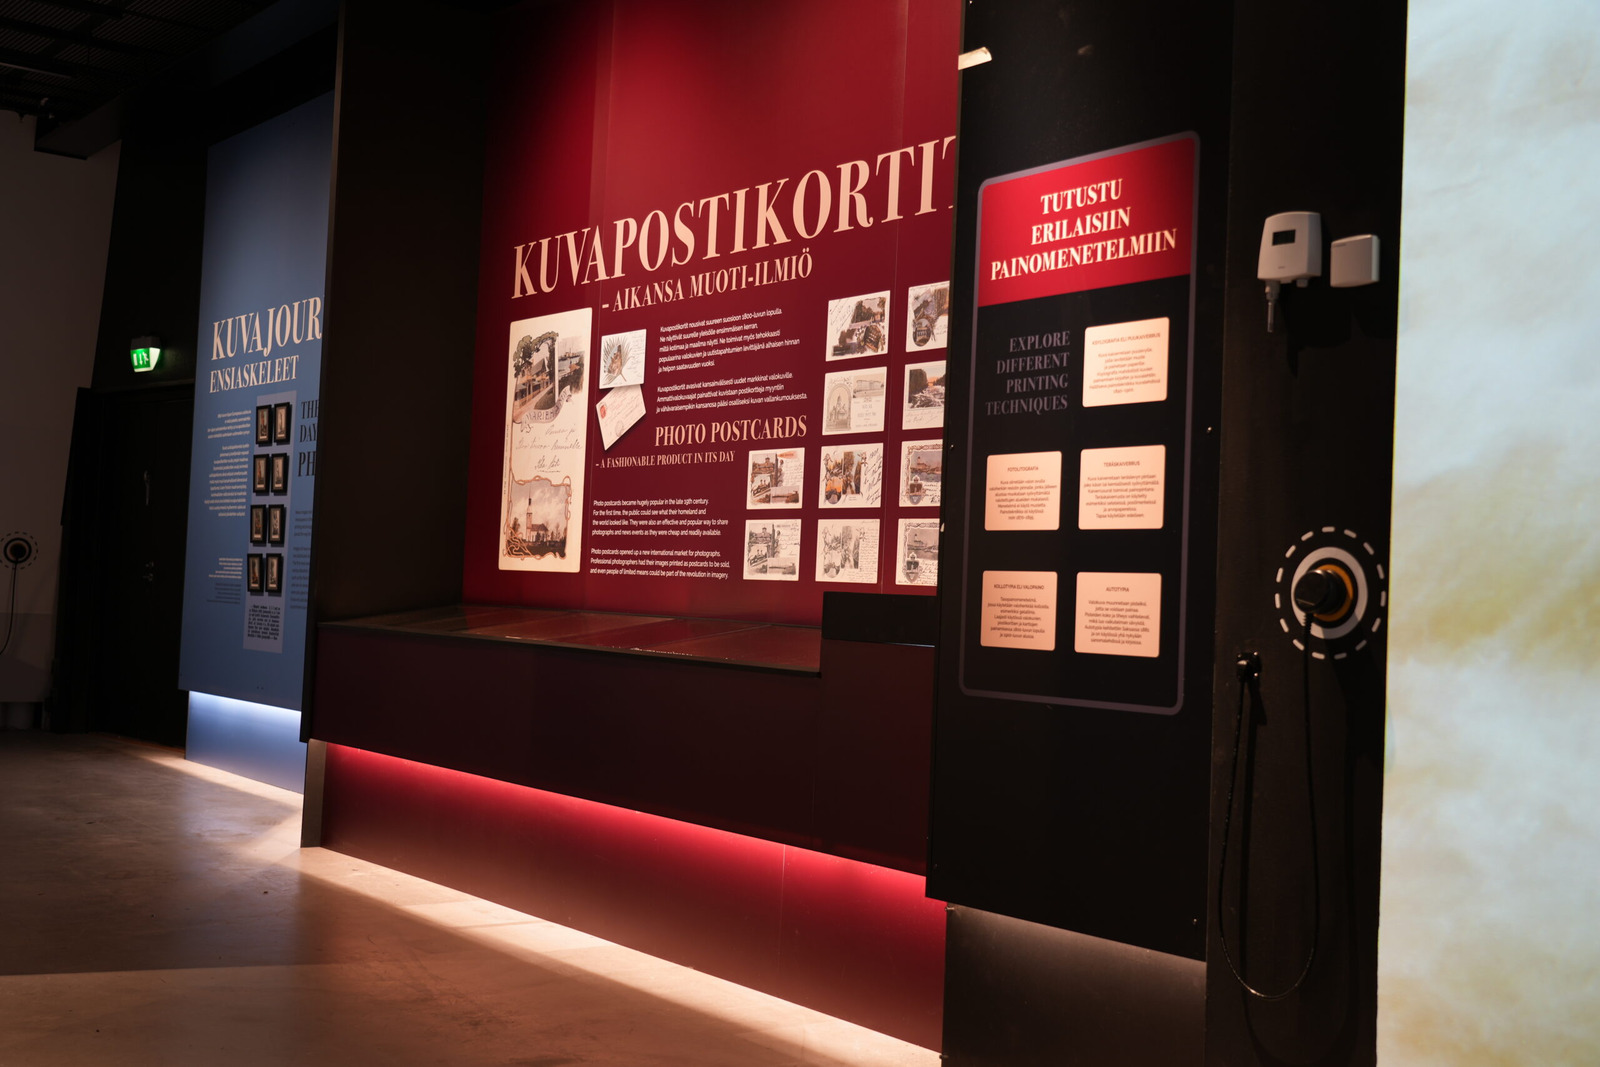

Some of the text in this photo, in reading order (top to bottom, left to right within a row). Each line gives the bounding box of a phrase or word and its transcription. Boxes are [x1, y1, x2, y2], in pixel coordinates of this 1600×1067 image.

[1040, 178, 1122, 215] TUTUSTU
[1031, 206, 1132, 246] ERILAISIIN
[990, 228, 1178, 281] PAINOMENETELMIIN
[612, 278, 684, 312] AIKANSA
[690, 248, 812, 298] MUOTI-ILMIÖ
[1010, 330, 1070, 352] EXPLORE
[209, 355, 300, 393] ENSIASKELEET
[996, 352, 1070, 374] DIFFERENT
[1006, 373, 1068, 394] PRINTING
[985, 395, 1068, 416] TECHNIQUES
[655, 415, 807, 446] PHOTO POSTCARDS
[600, 457, 605, 468] A
[607, 453, 656, 468] FASHIONABLE
[657, 452, 692, 465] PRODUCT
[694, 452, 703, 463] IN
[705, 451, 718, 463] ITS
[719, 451, 736, 462] DAY
